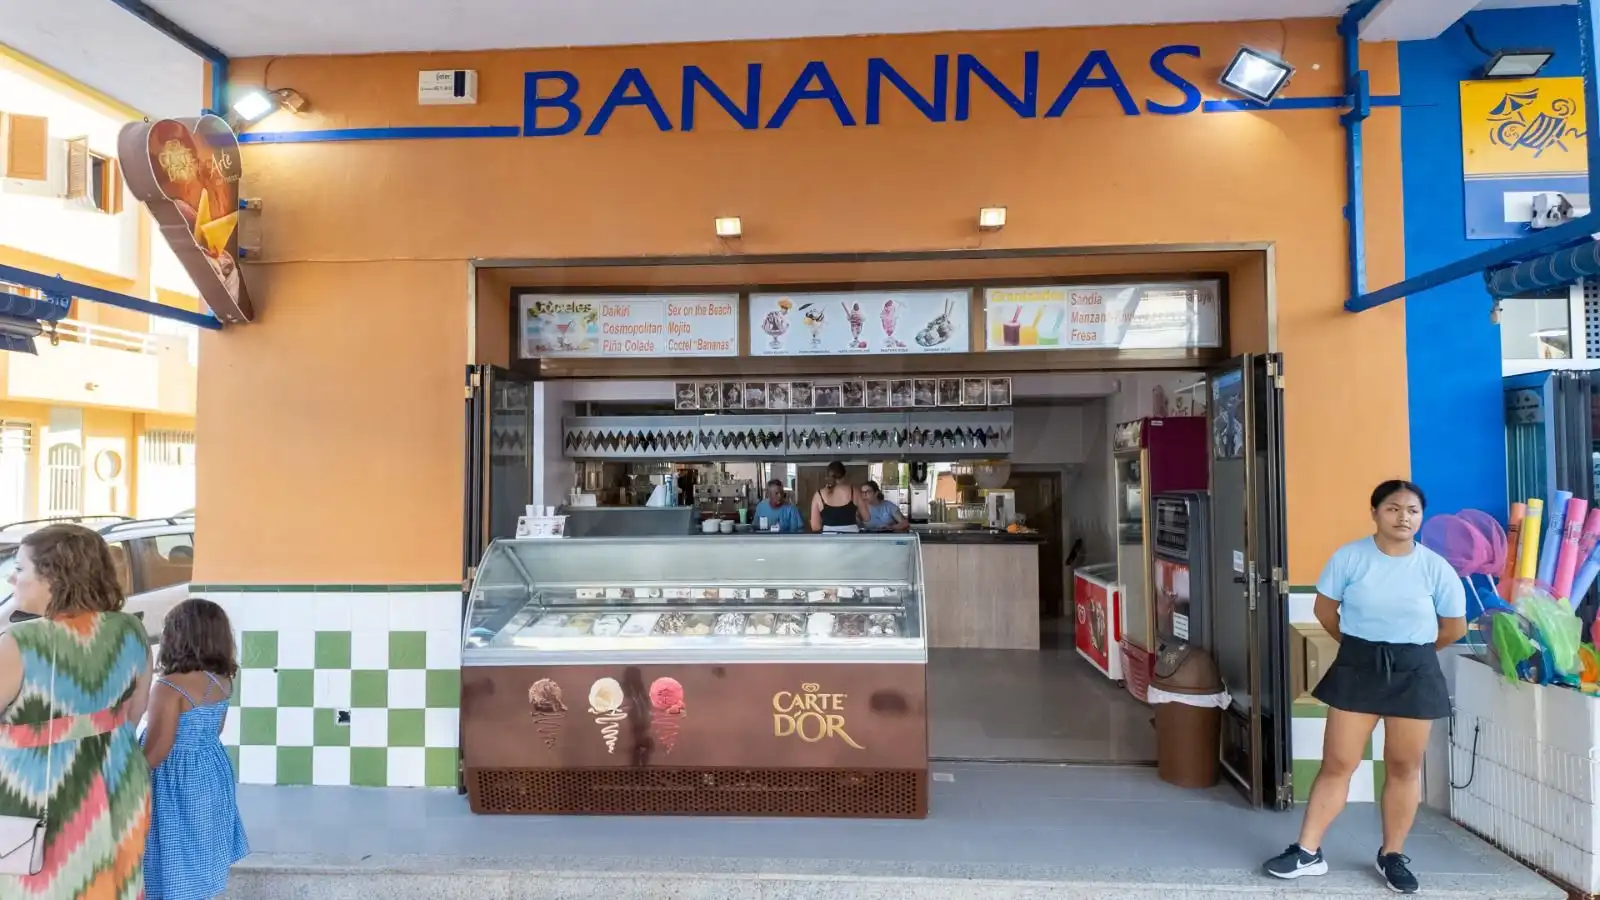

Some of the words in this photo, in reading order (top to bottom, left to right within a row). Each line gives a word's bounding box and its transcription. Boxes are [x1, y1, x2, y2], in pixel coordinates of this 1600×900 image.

[523, 45, 1202, 137] BANANNAS
[667, 304, 681, 316] Sex
[683, 306, 693, 316] on
[695, 304, 707, 316] the
[708, 304, 732, 316] Beach
[1071, 311, 1109, 324] Manzan
[602, 323, 662, 336] Cosmopolitan
[667, 322, 691, 336] Mojito
[1071, 328, 1097, 341] Fresa
[772, 691, 848, 714] CARTE
[773, 710, 866, 749] D'OR
